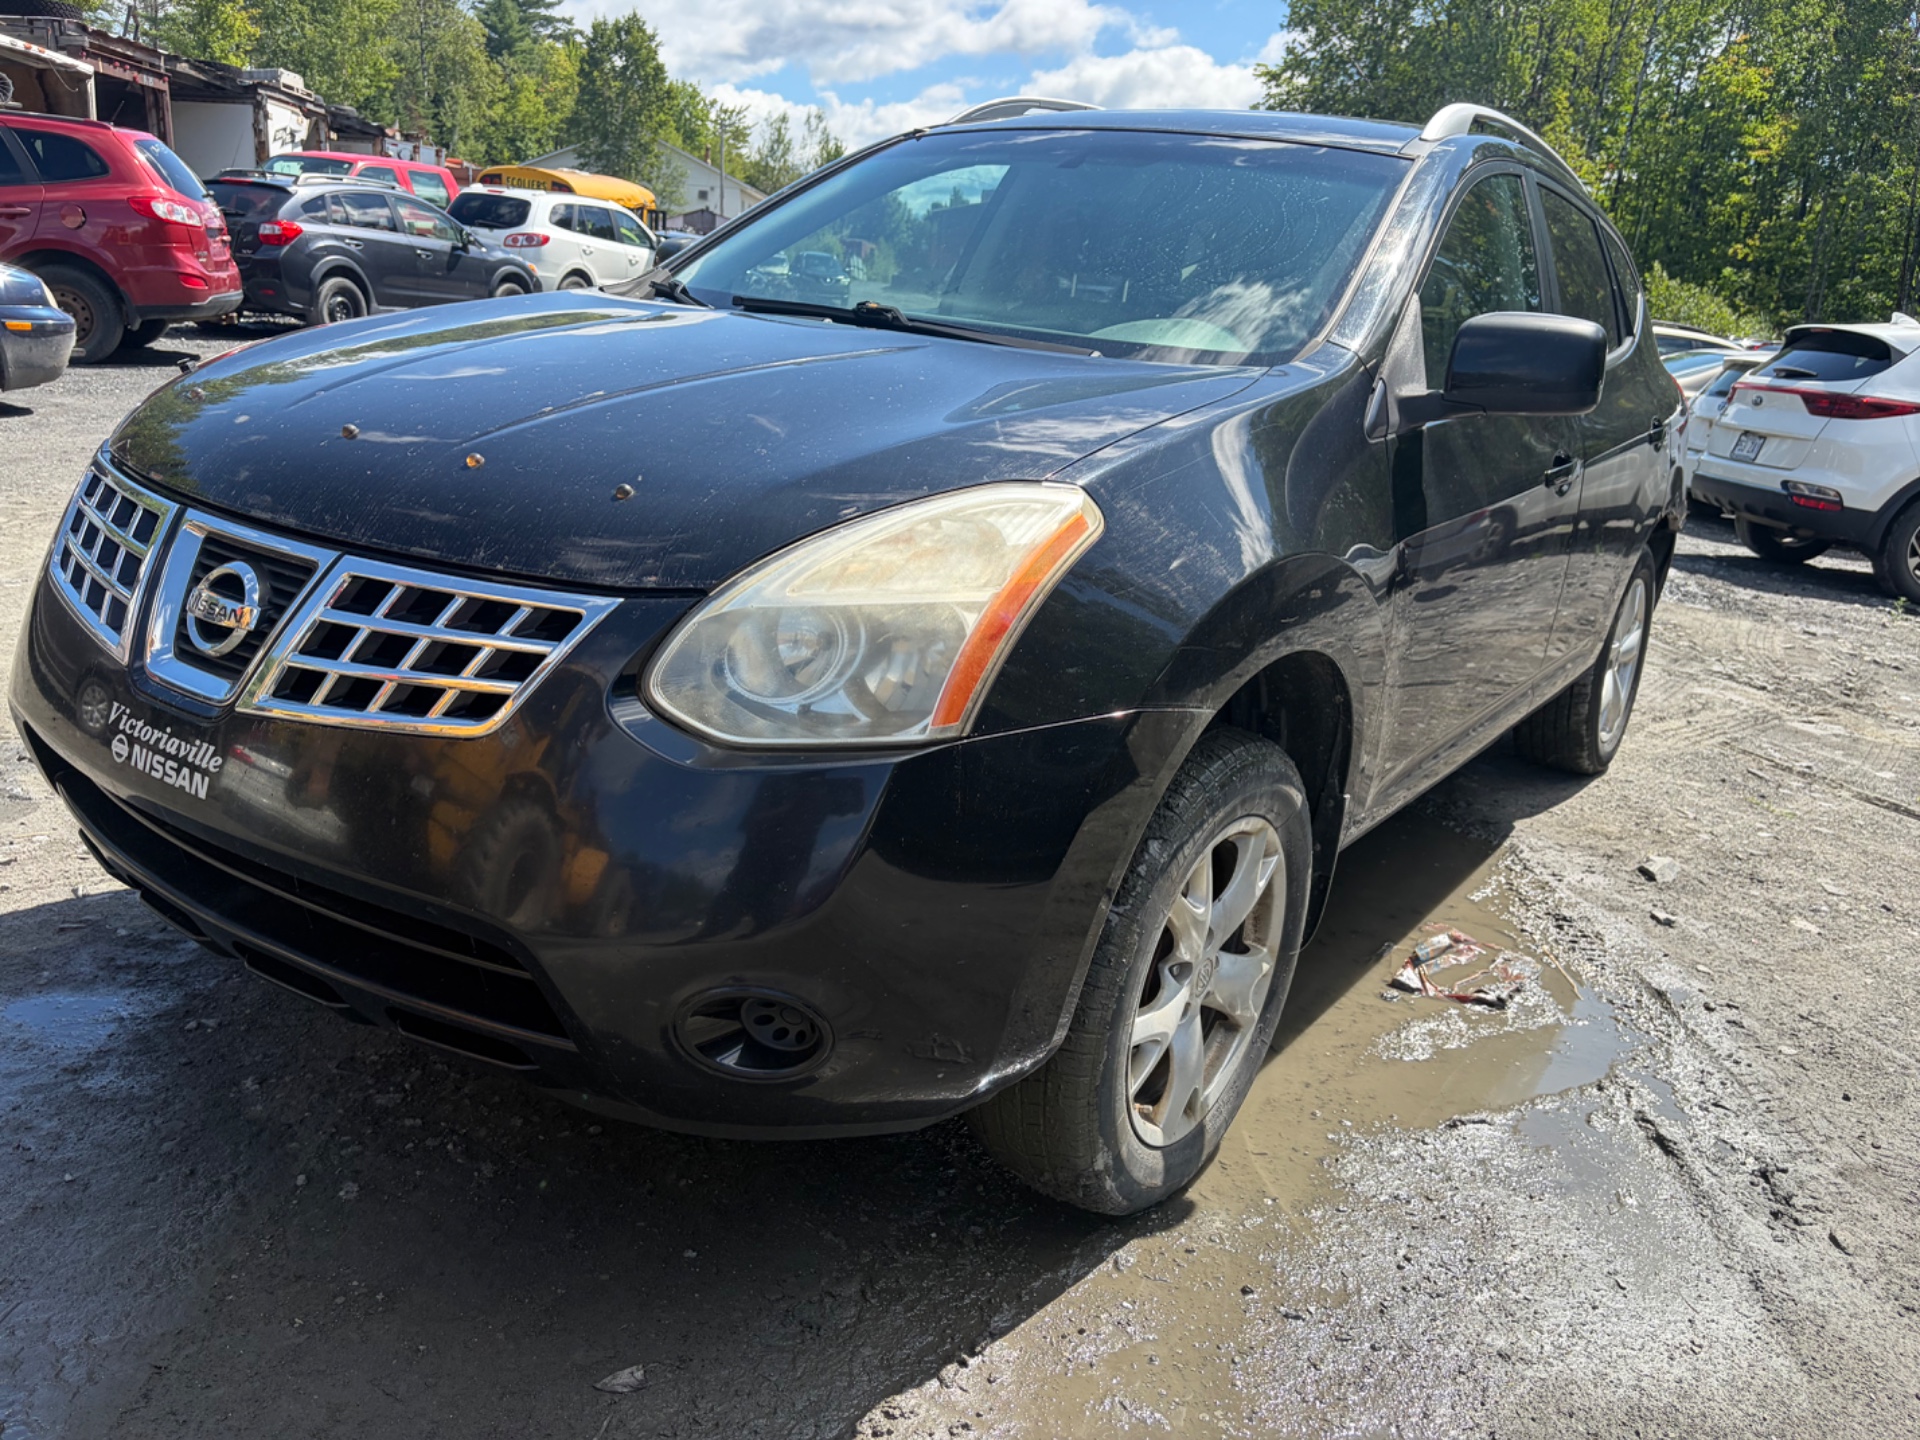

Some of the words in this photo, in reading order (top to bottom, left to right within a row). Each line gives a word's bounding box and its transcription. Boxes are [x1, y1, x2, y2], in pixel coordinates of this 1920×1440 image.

[189, 588, 244, 623] NISSAN
[108, 701, 223, 773] Victoriaville
[130, 743, 210, 800] NISSAN
